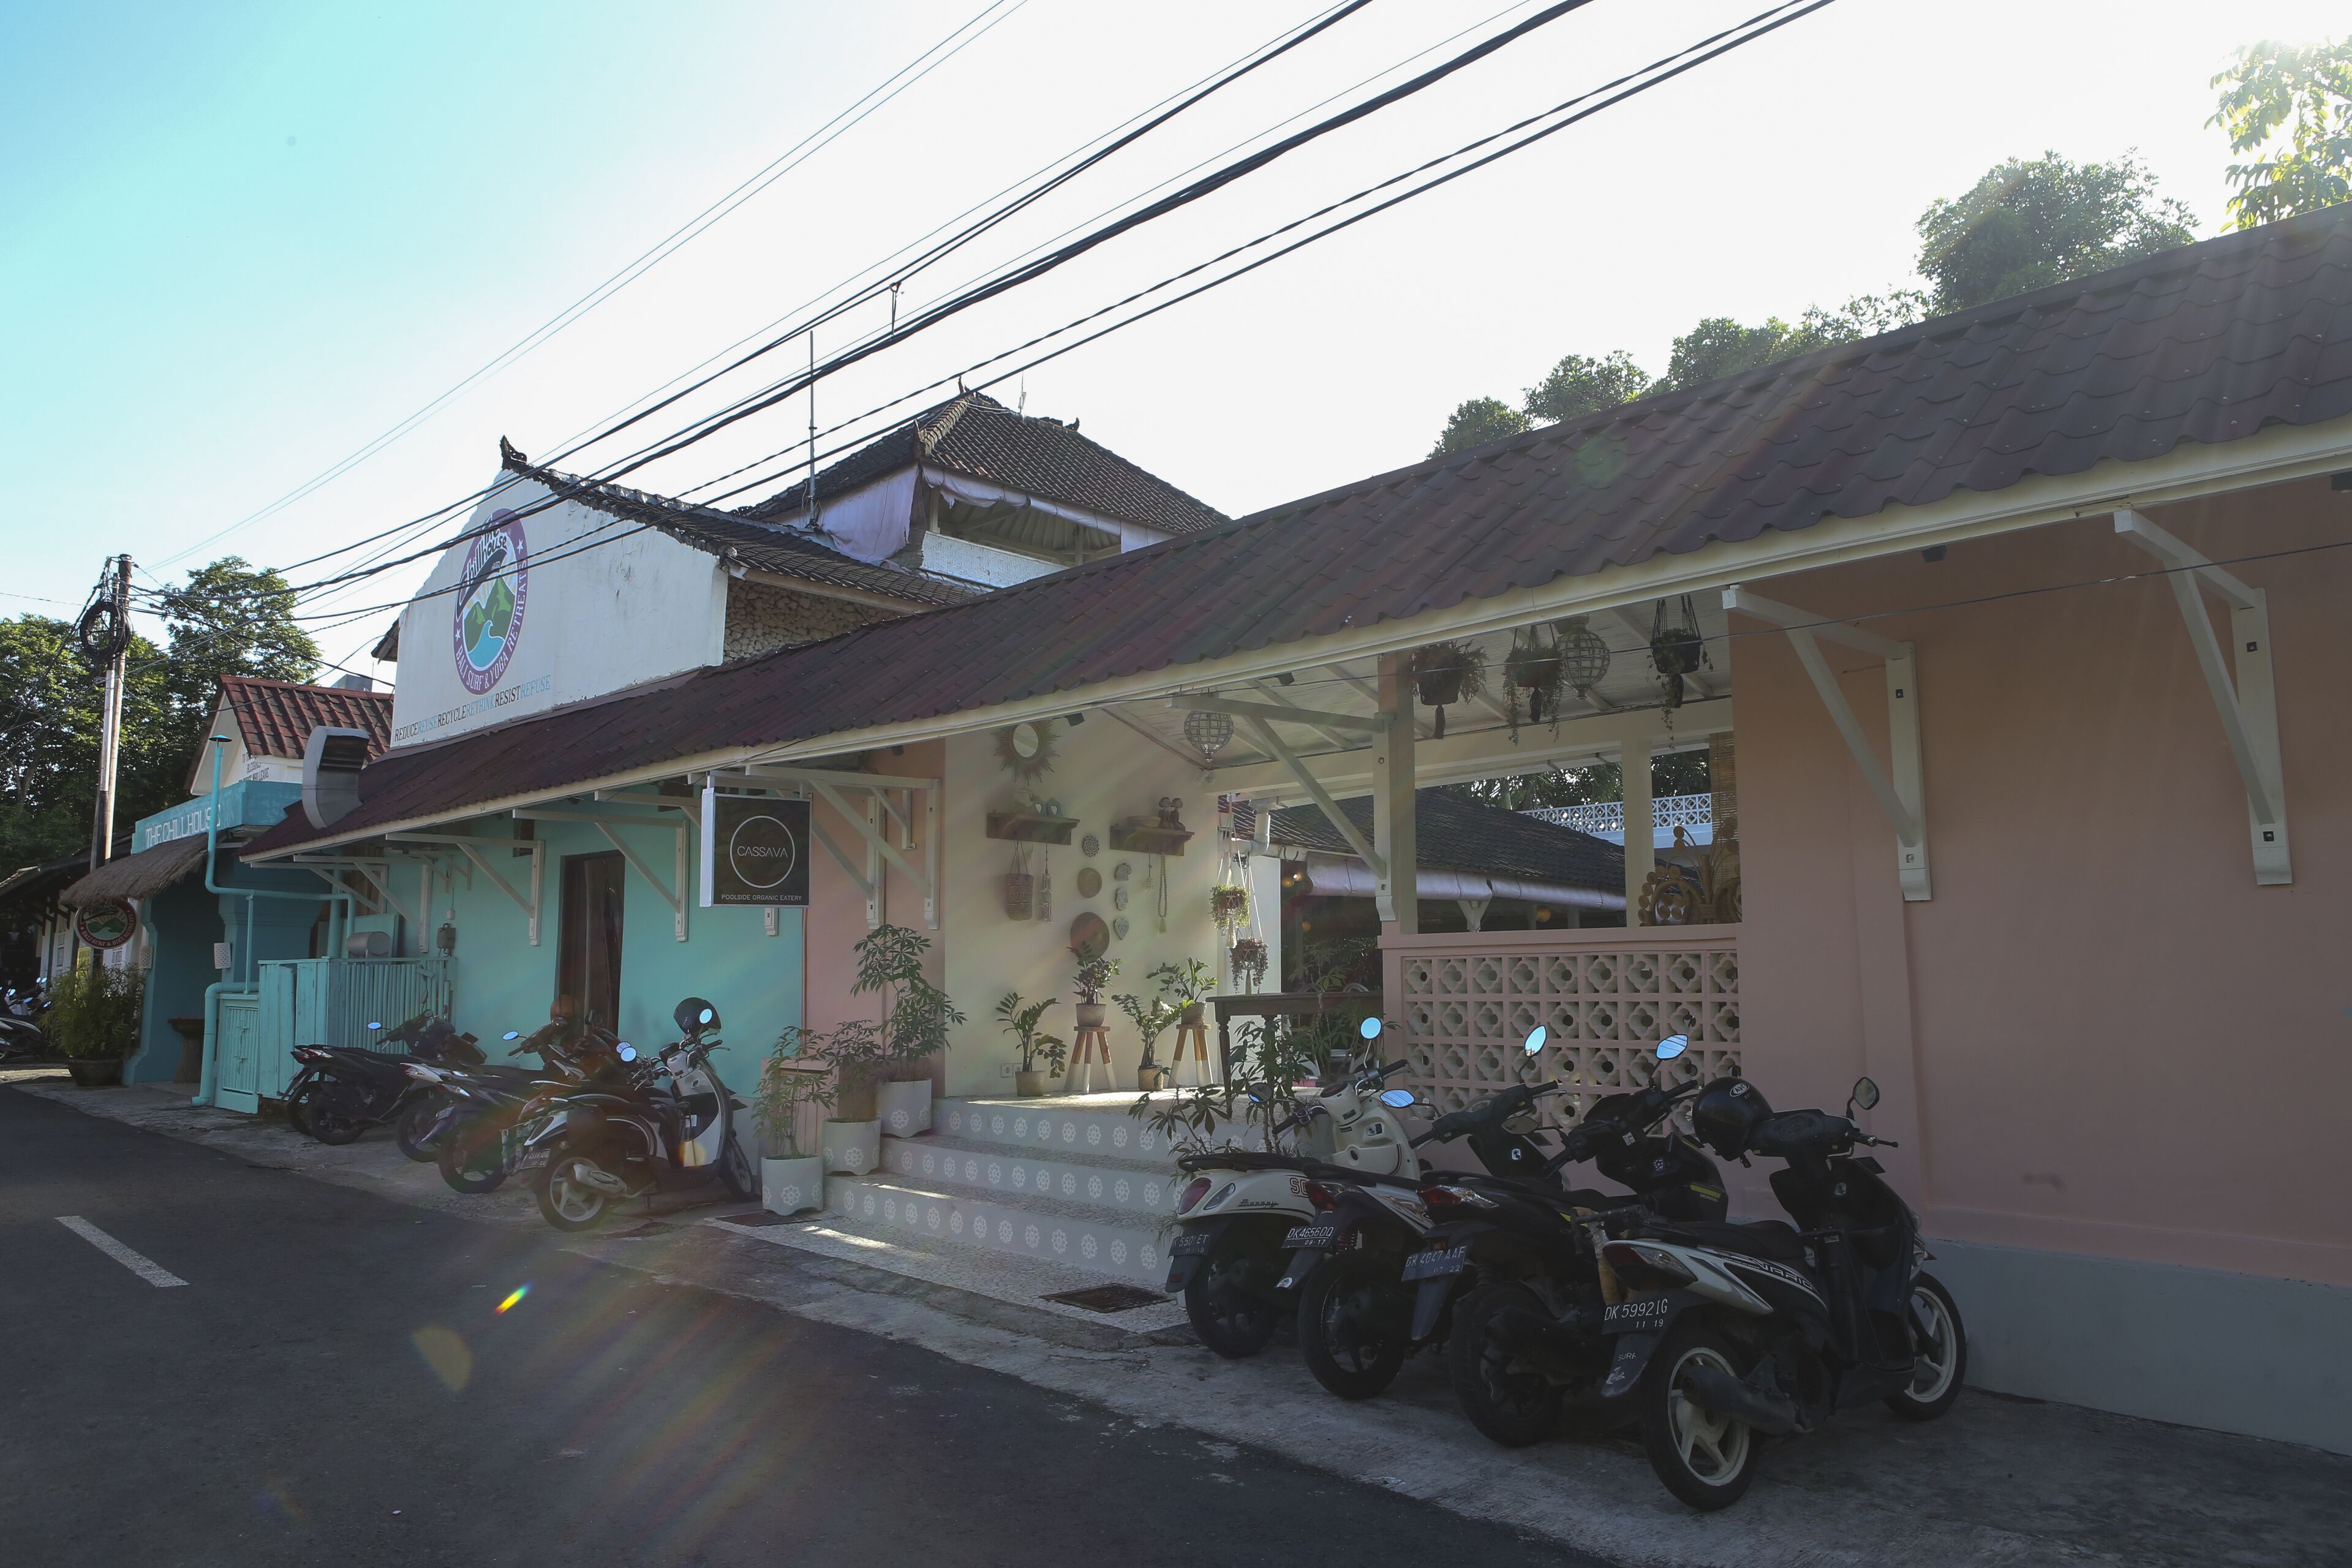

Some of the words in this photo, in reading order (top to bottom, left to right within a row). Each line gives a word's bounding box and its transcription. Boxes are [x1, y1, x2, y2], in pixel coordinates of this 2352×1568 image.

[456, 645, 469, 679] BALI
[466, 671, 484, 691] SURF
[484, 674, 490, 688] &
[489, 651, 509, 684] YOGA
[507, 560, 528, 652] RETREATS
[146, 824, 162, 848] THE
[737, 845, 788, 858] CASSAVA
[1604, 1305, 1620, 1321] DK
[1621, 1301, 1654, 1318] 5992
[1656, 1298, 1668, 1315] IG
